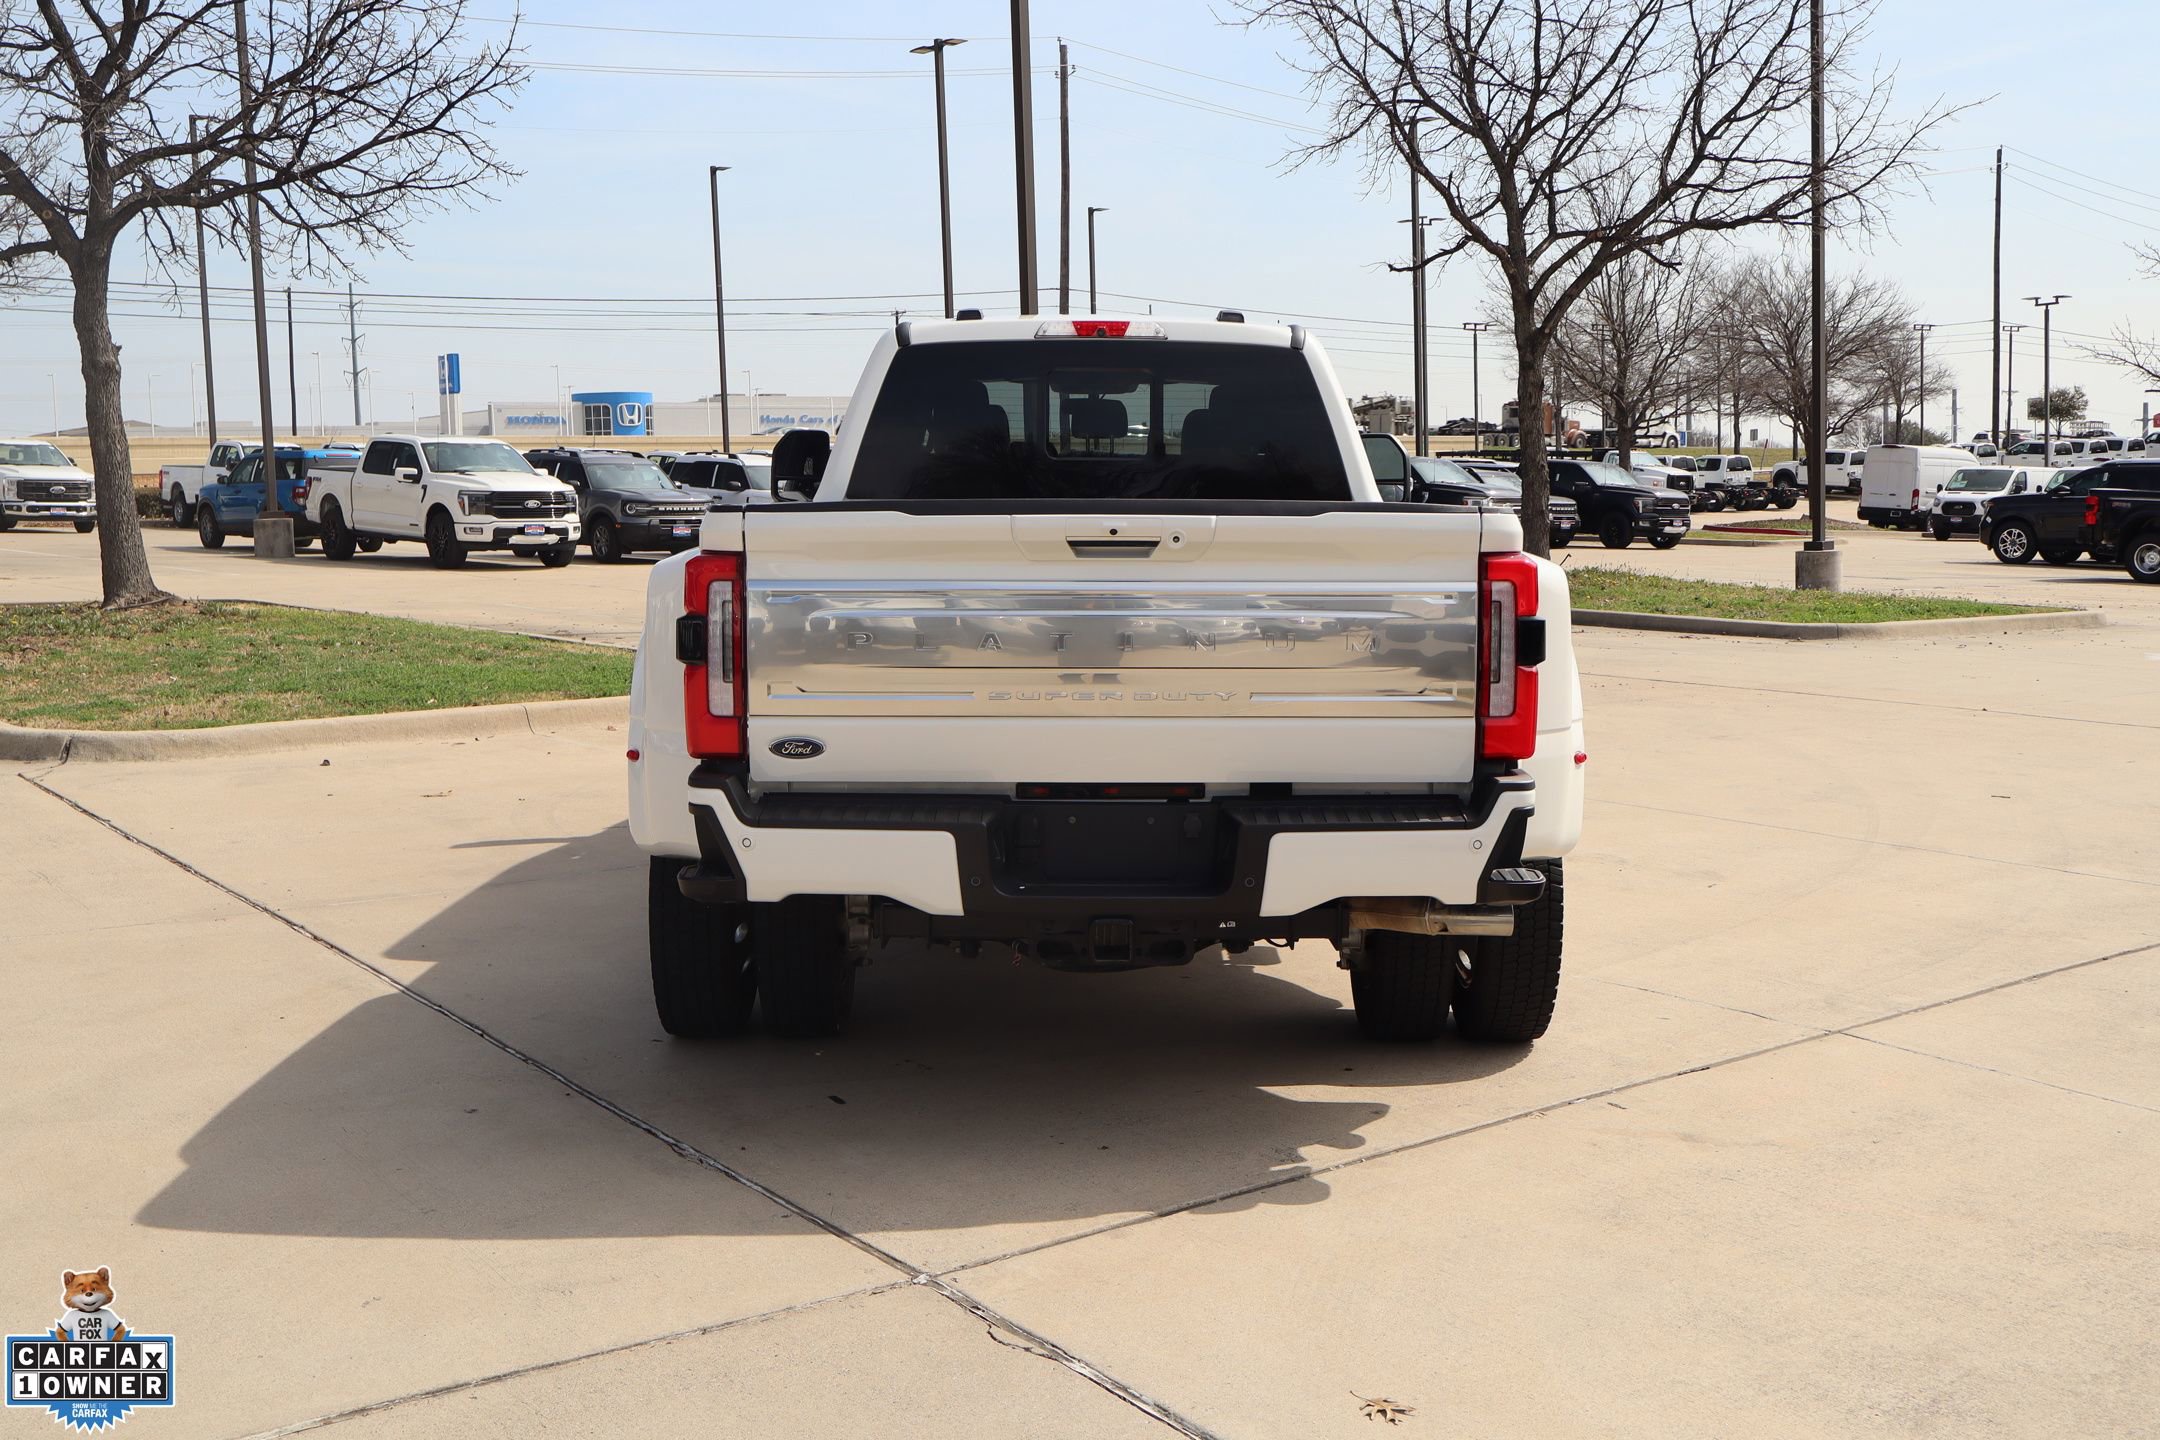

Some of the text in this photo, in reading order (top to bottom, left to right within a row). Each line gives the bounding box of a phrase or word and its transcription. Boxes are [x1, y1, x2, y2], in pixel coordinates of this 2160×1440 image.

[506, 416, 567, 425] HONDA
[760, 414, 796, 424] Honda
[799, 414, 824, 424] Cars
[847, 632, 1380, 652] PLATINUM
[988, 690, 1238, 701] SUPER DUTY
[781, 741, 813, 754] Ford
